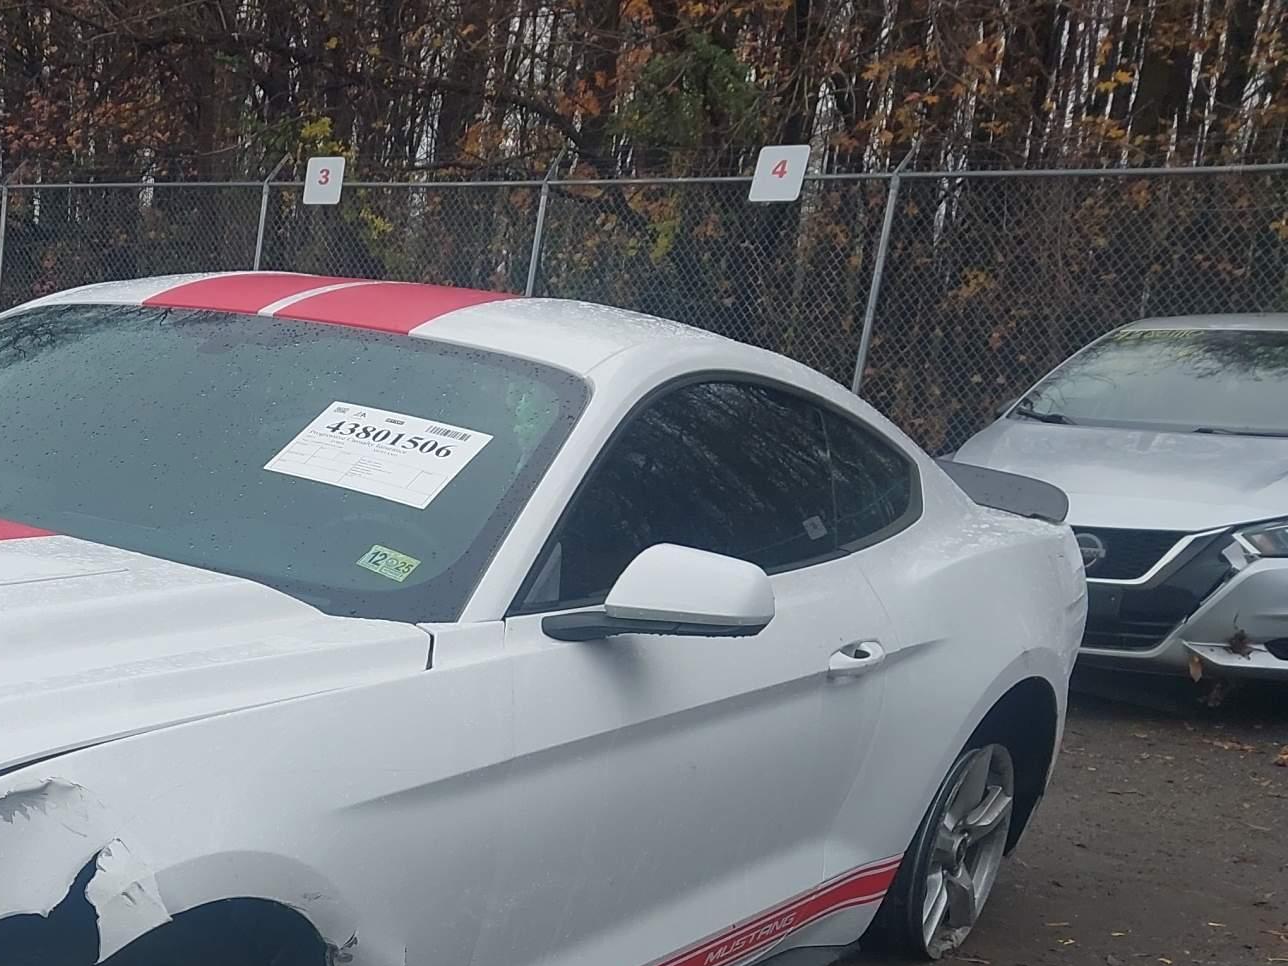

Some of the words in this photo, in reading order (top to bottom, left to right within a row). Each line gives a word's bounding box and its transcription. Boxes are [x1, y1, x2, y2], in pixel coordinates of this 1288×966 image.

[318, 168, 330, 185] 3
[772, 160, 787, 178] 4
[325, 420, 457, 458] 43801506
[368, 551, 388, 567] 12
[394, 561, 414, 574] 25
[704, 912, 797, 966] MUSTANG
